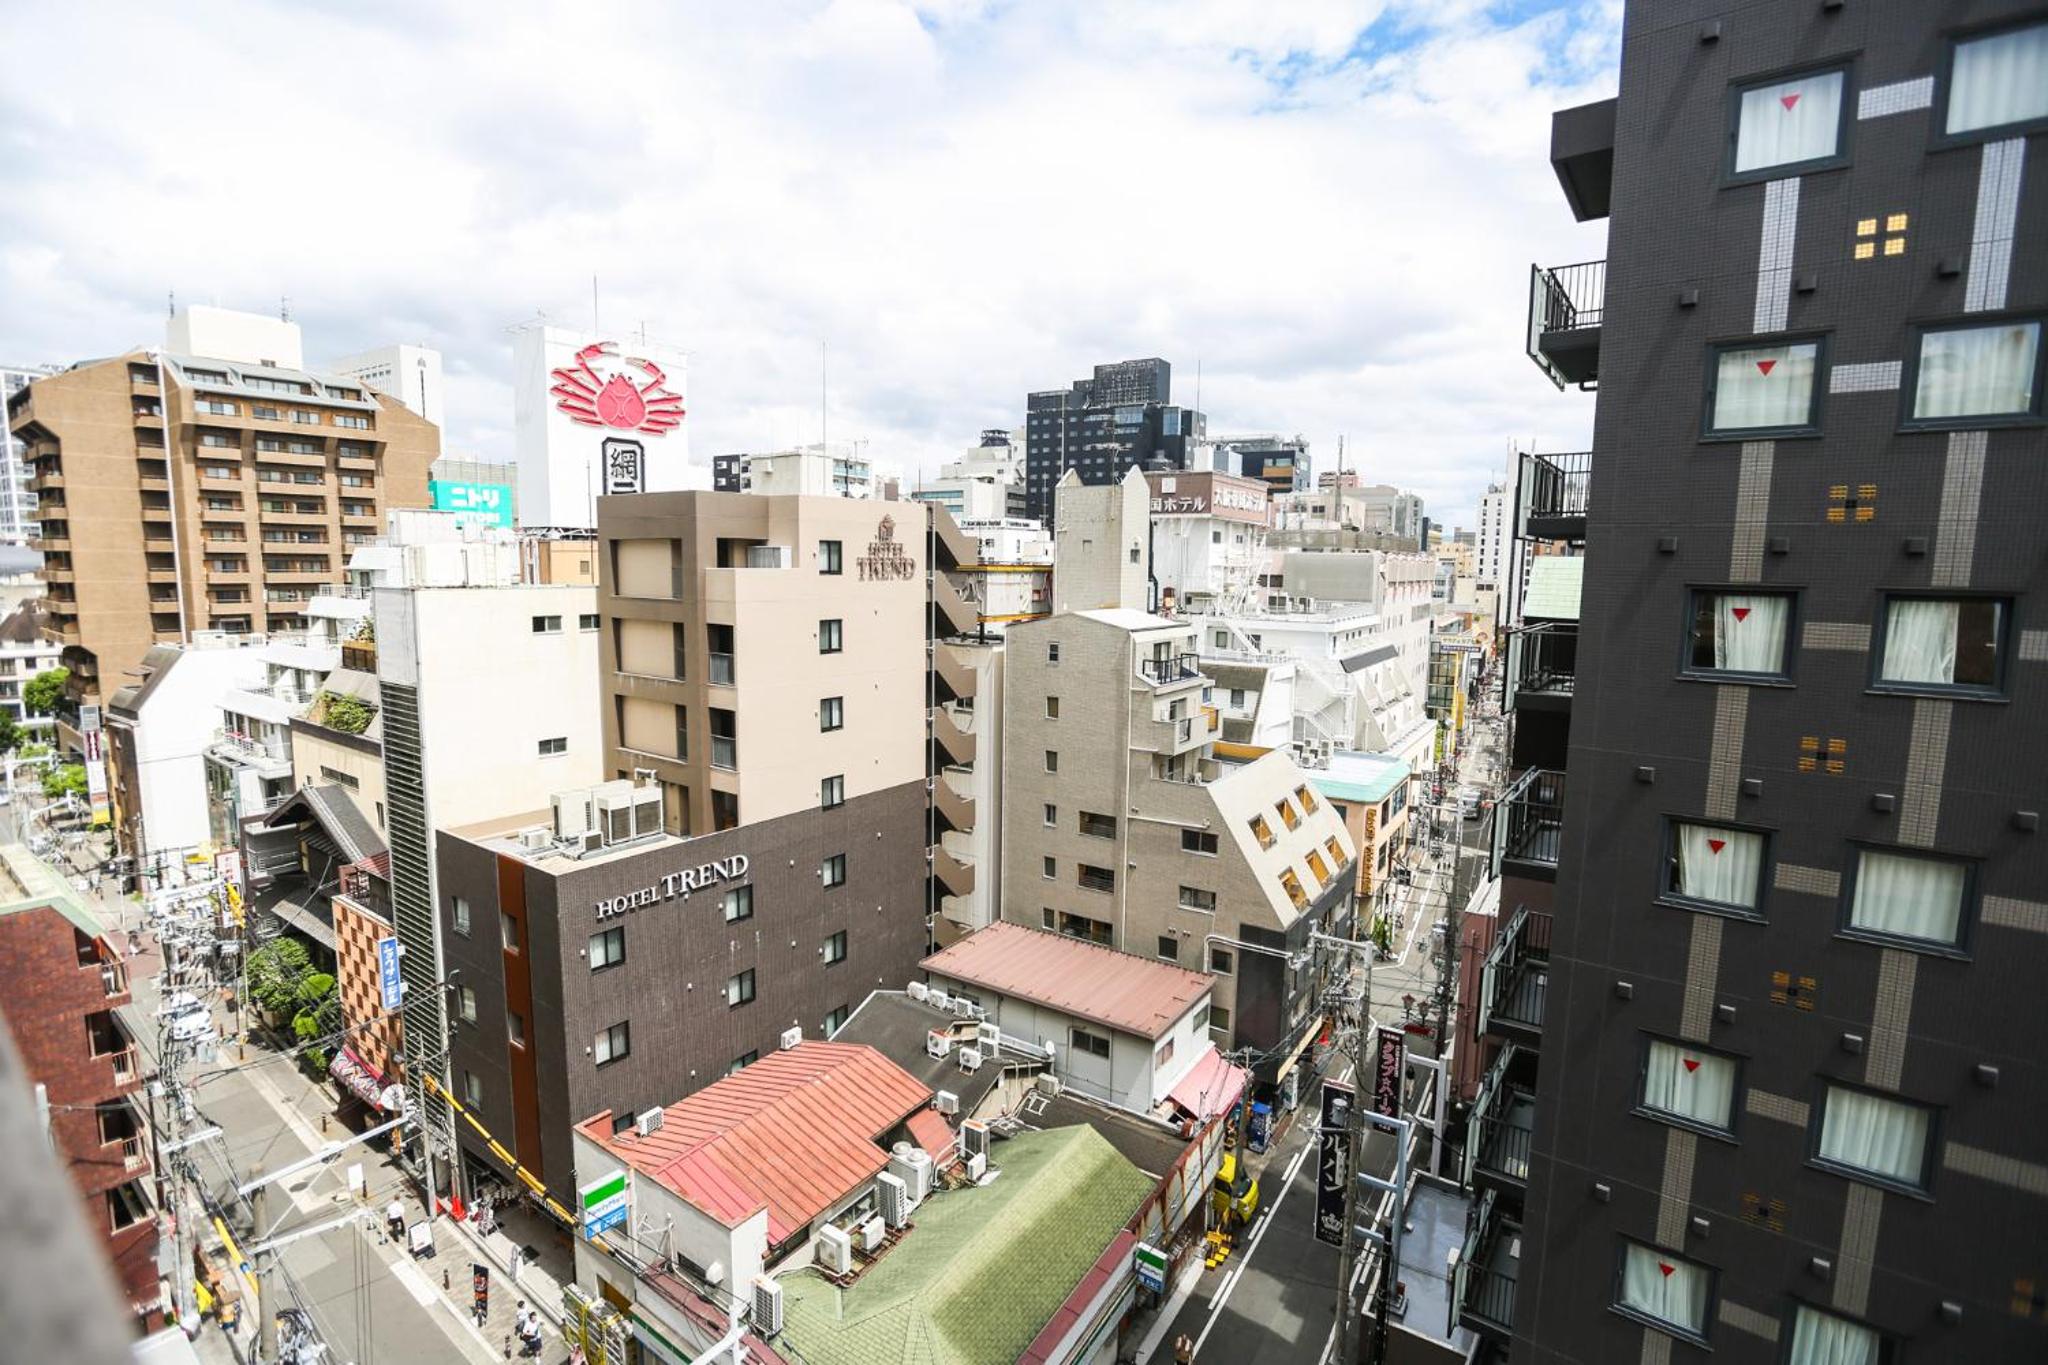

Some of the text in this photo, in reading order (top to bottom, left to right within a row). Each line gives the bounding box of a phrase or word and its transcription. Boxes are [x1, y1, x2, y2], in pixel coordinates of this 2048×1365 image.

[451, 486, 499, 509] ニトリ
[855, 556, 917, 581] TREND
[596, 854, 749, 918] HOTEL TREND
